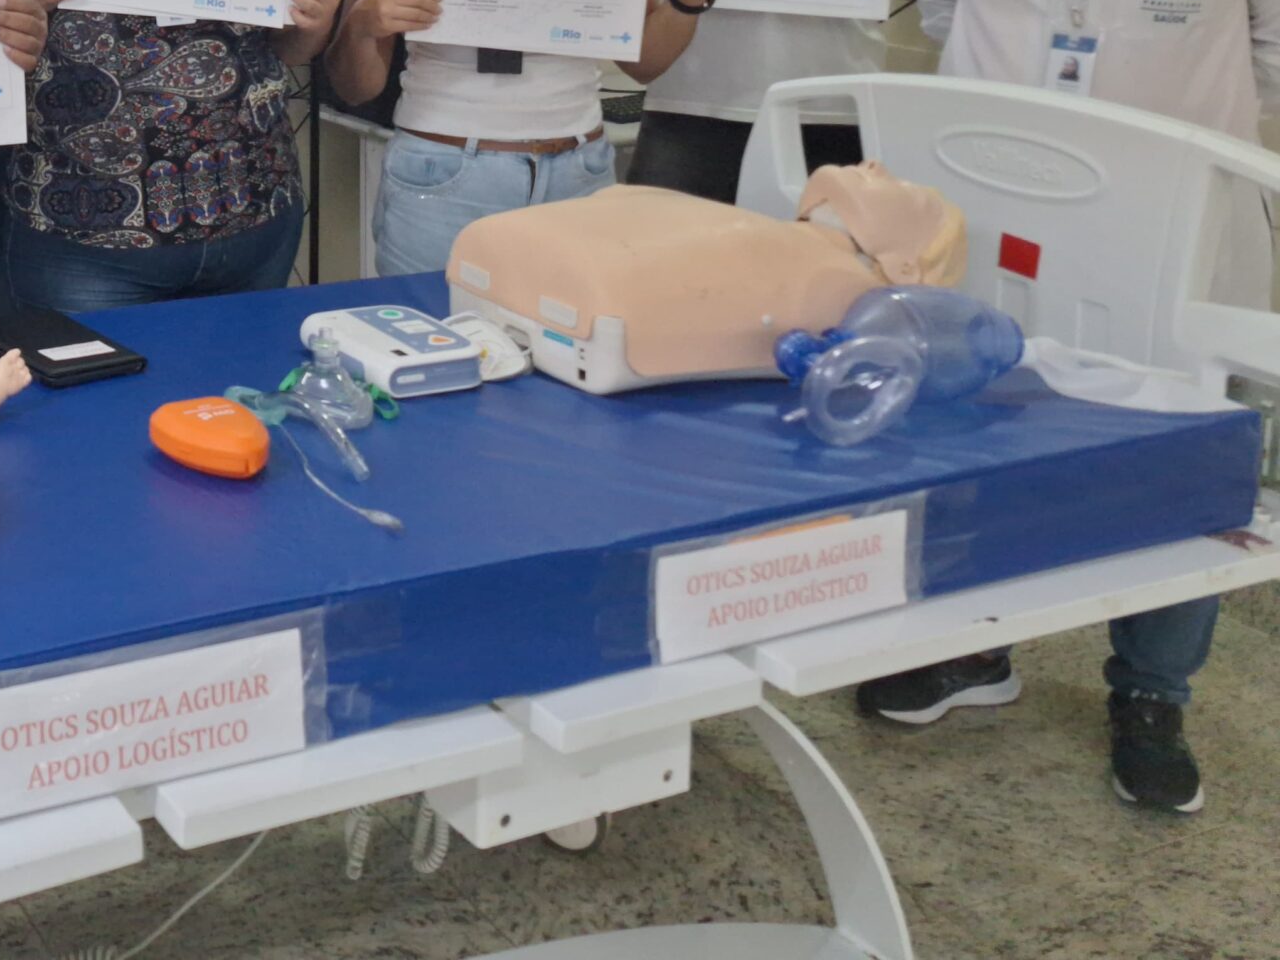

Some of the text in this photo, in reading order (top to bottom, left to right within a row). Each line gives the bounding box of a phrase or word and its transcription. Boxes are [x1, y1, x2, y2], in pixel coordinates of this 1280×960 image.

[686, 534, 883, 596] OTICS SOUZA AGUIAR
[707, 572, 870, 628] APOIO LOGÍSTICO
[0, 673, 270, 752] OTICS SOUZA AGUIAR
[27, 718, 249, 791] APOIO LOGÍSTICO
